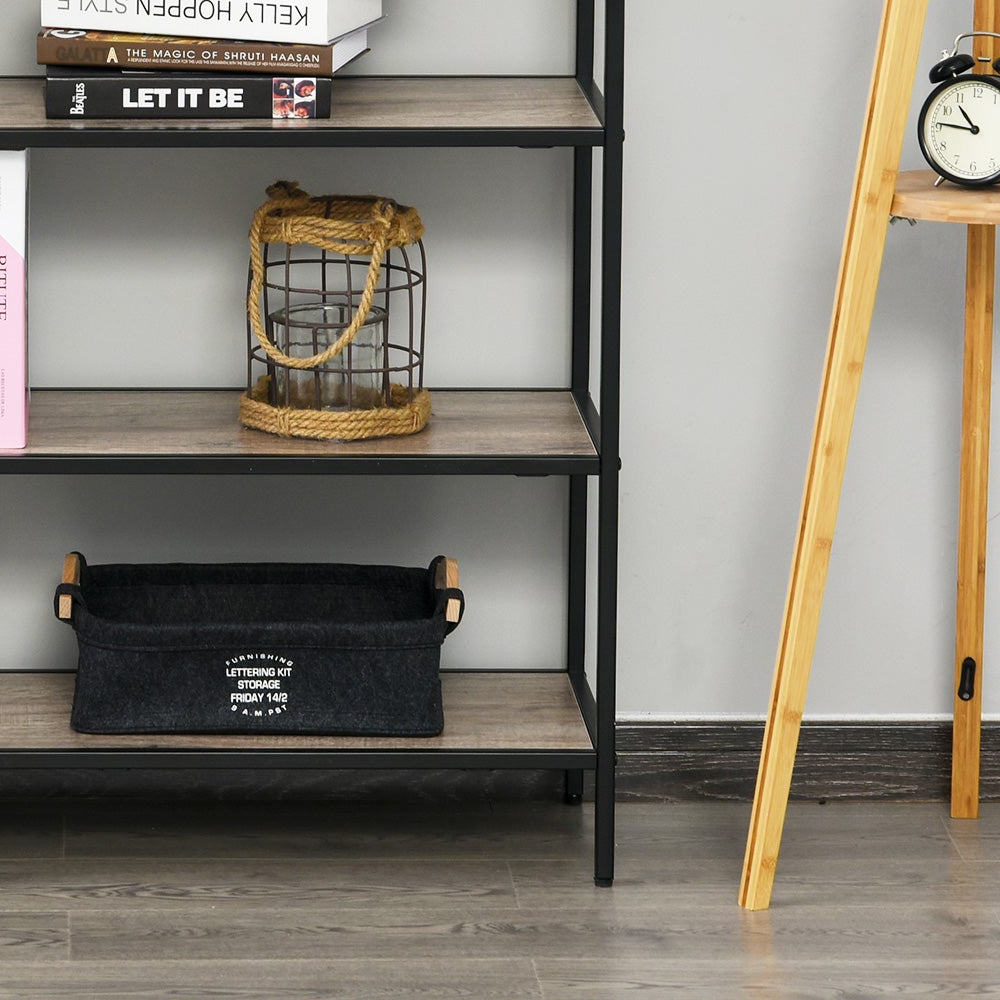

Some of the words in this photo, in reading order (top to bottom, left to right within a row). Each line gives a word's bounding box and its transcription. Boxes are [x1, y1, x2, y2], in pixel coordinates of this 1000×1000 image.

[239, 6, 309, 27] KELLY
[126, 48, 147, 59] THE
[153, 49, 197, 61] MAGIC
[202, 50, 220, 61] OF
[224, 51, 266, 63] SHRUTI
[269, 53, 321, 64] HAASAN
[69, 82, 87, 115] BEATLES
[122, 88, 173, 109] LET
[177, 88, 203, 109] IT
[208, 88, 244, 109] BE
[956, 92, 964, 104] 11
[973, 87, 984, 99] 12
[993, 94, 997, 105] 1
[942, 105, 953, 116] 10
[939, 141, 947, 151] 8
[953, 154, 961, 166] 7
[969, 160, 977, 172] 6
[988, 158, 996, 168] 5
[225, 653, 294, 666] FURNISHING
[226, 668, 276, 677] LETTERING
[277, 668, 292, 677] KIT
[237, 680, 281, 690] STORAGE
[230, 693, 264, 703] FRIDAY
[266, 693, 288, 703] 14/2
